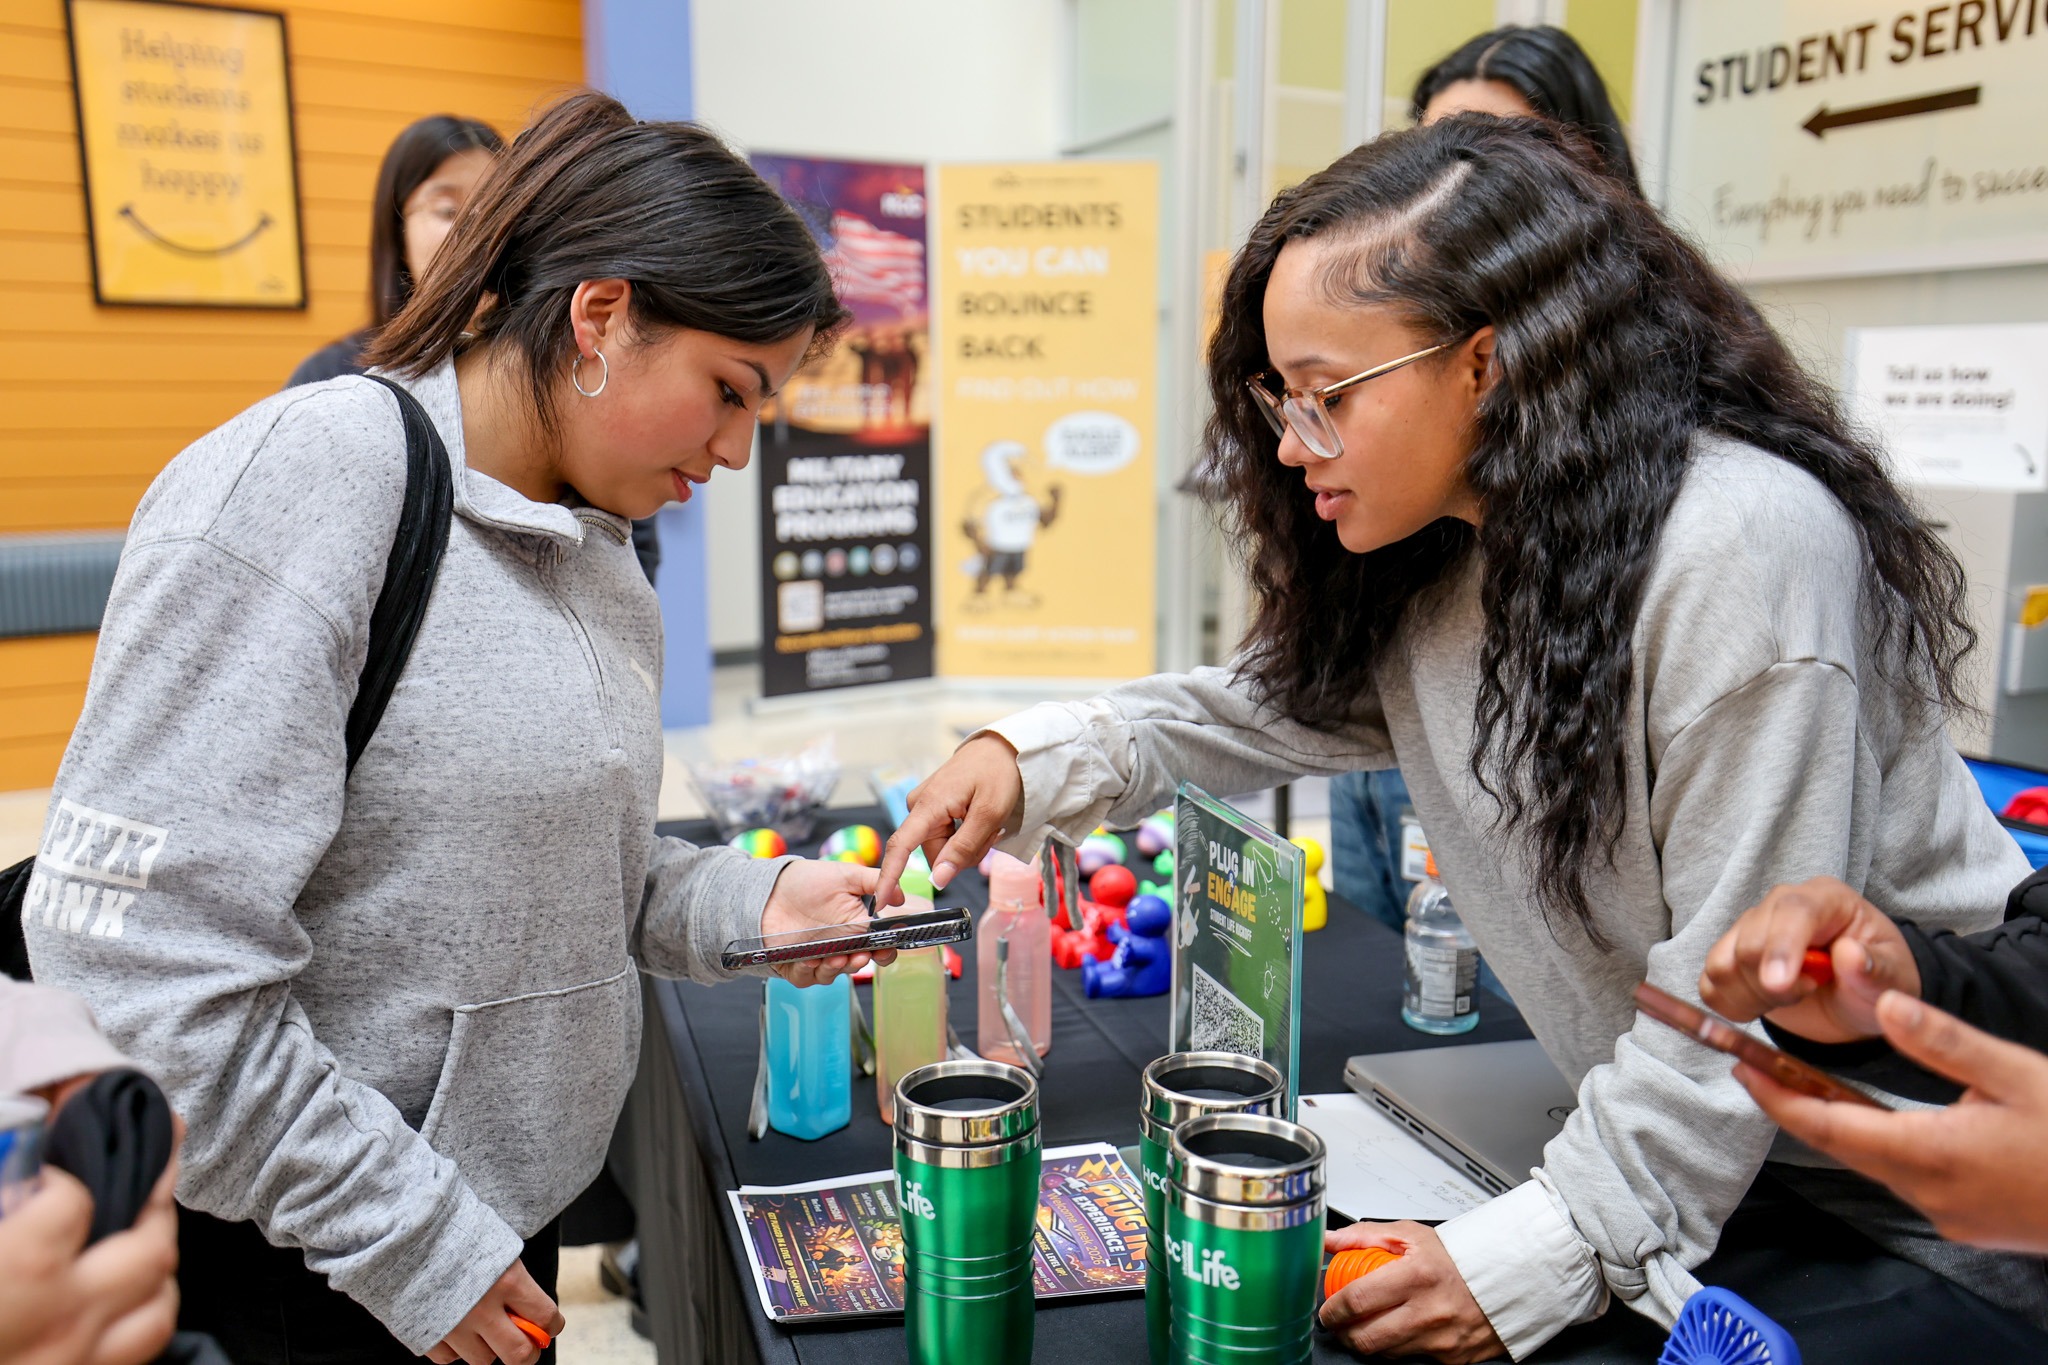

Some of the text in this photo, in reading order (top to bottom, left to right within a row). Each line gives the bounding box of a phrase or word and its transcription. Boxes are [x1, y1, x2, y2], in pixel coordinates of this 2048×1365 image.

[120, 28, 244, 75] Helping
[1694, 0, 2048, 105] STUDENT SERVI
[121, 78, 250, 113] students
[117, 119, 264, 155] makes us
[139, 160, 244, 203] happy
[1713, 175, 1822, 241] Everything
[1829, 189, 1866, 234] you
[1873, 156, 1936, 208] need
[1941, 168, 1966, 202] to
[957, 203, 1122, 231] STUDENTS
[956, 246, 1109, 277] YOU CAN
[959, 292, 1092, 317] BOUNCE
[959, 335, 1045, 360] BACK
[1951, 364, 1990, 382] how
[1886, 393, 1907, 405] we
[1916, 393, 1942, 405] are
[787, 454, 905, 485] MILITARY
[773, 479, 919, 515] EDUCATION
[776, 507, 917, 543] PROGRAMS
[44, 807, 158, 880] PINK
[1209, 840, 1255, 888] PLUG IN
[22, 871, 136, 938] PINK
[1207, 871, 1257, 923] ENGAGE
[825, 1196, 844, 1220] THURSDAY
[875, 1188, 897, 1217] WEDNESDAY
[896, 1172, 936, 1220] Life
[769, 1219, 784, 1238] PLUGGED
[1047, 1192, 1106, 1266] Welcome Week 2026
[1071, 1194, 1125, 1254] EXPERIENCE
[1082, 1183, 1147, 1261] PLUG IN
[780, 1247, 791, 1260] LEVEL
[1045, 1252, 1061, 1268] LEVEL
[1055, 1267, 1068, 1277] UP!
[1187, 1242, 1241, 1291] Life
[787, 1266, 798, 1279] YOUR
[791, 1279, 805, 1298] CAMPUS
